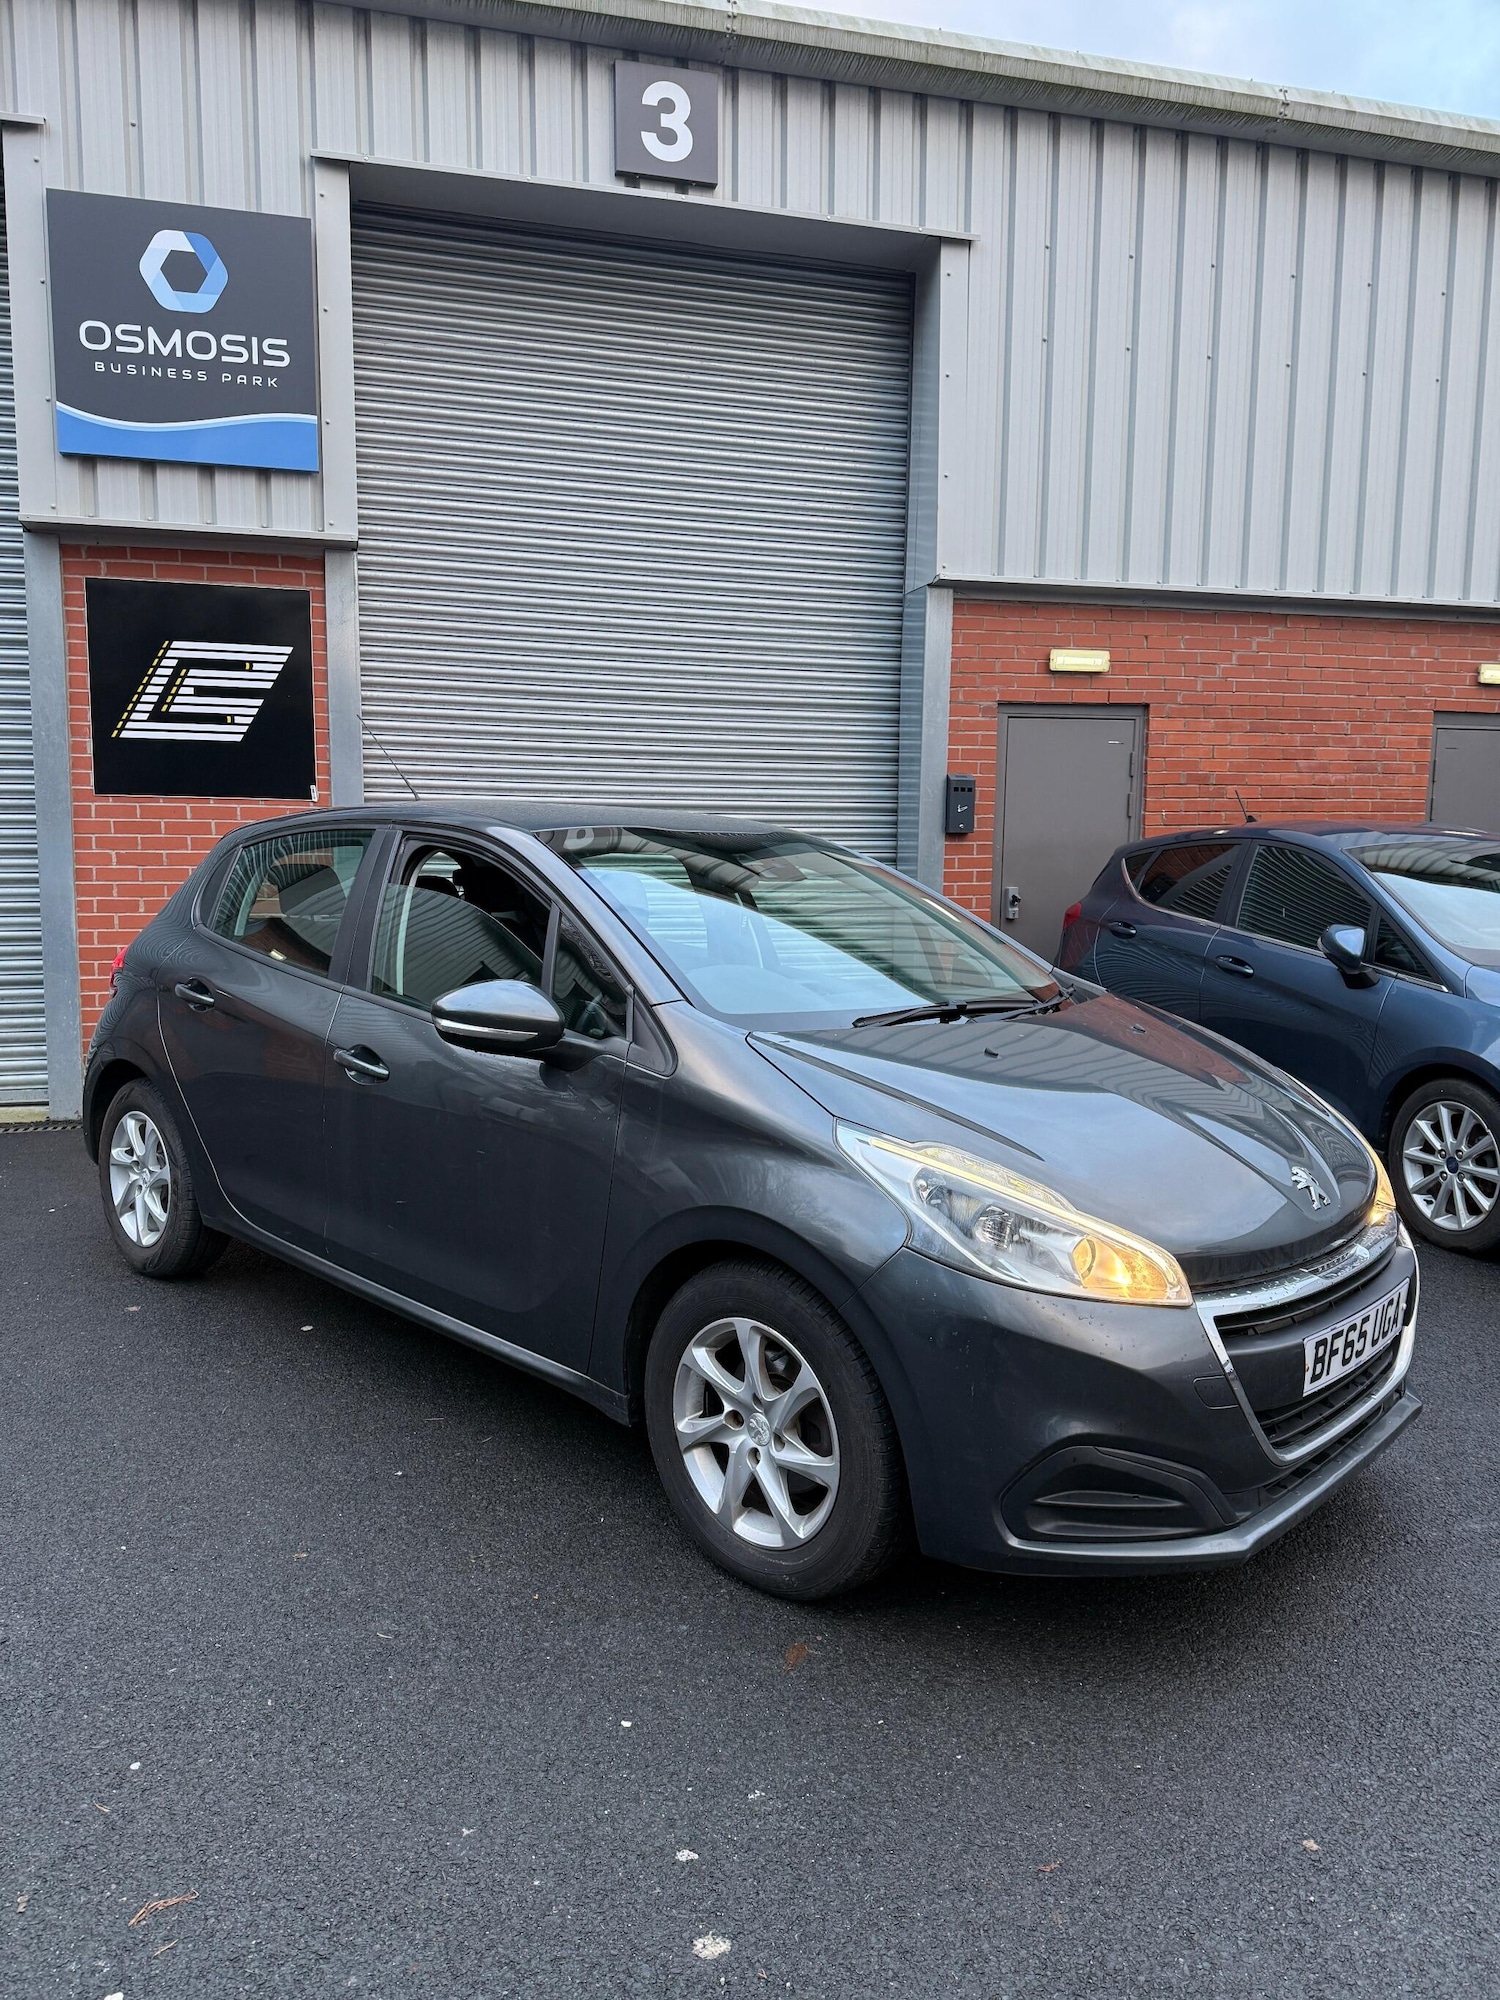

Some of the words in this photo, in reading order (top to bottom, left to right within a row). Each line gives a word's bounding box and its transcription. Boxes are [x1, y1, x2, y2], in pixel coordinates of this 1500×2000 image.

[641, 81, 693, 162] 3
[79, 320, 291, 367] OSMOSIS
[95, 362, 208, 381] BUSINESS
[222, 373, 278, 388] PARK
[1310, 1314, 1371, 1384] BF65
[1372, 1292, 1401, 1348] UGA
